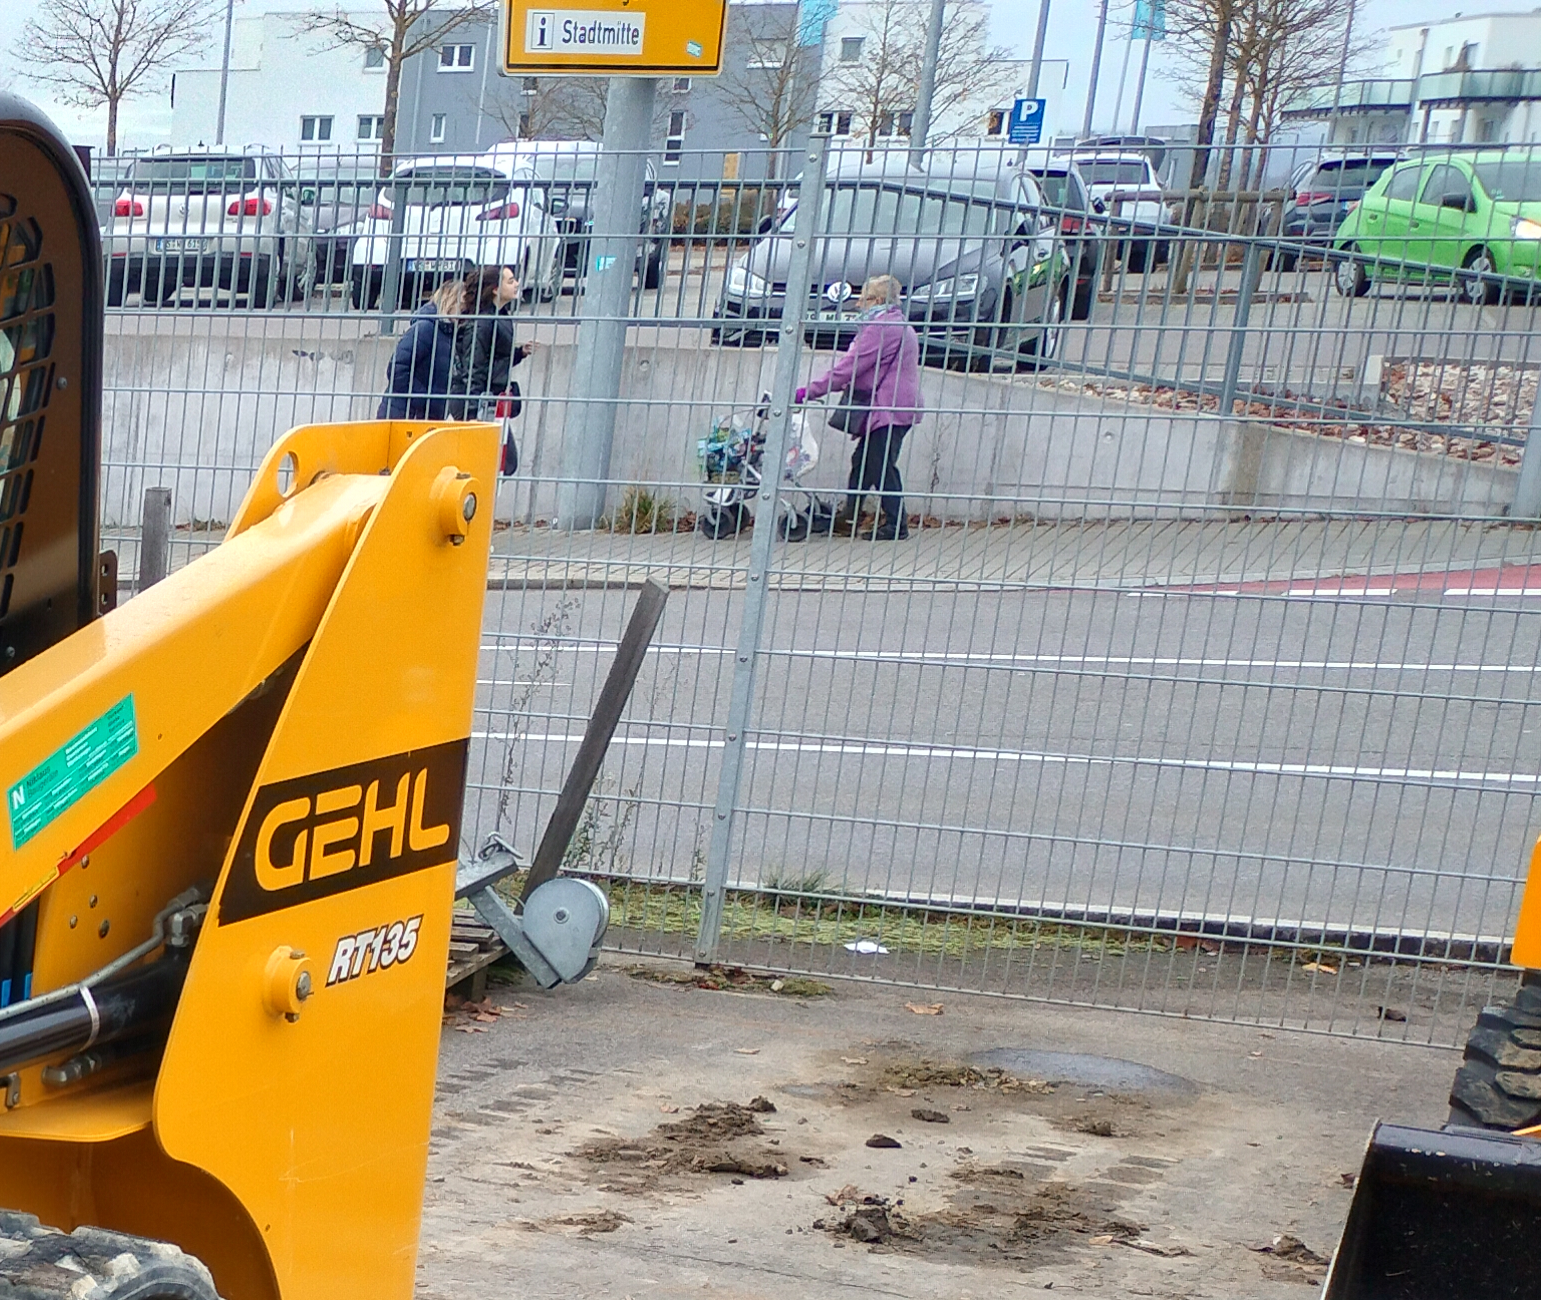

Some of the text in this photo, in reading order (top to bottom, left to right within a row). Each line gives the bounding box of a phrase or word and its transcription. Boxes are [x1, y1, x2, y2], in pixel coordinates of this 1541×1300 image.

[562, 19, 640, 45] Stadtmitte
[1020, 101, 1039, 121] P
[254, 767, 450, 891] GEHL
[325, 914, 424, 987] RT135
